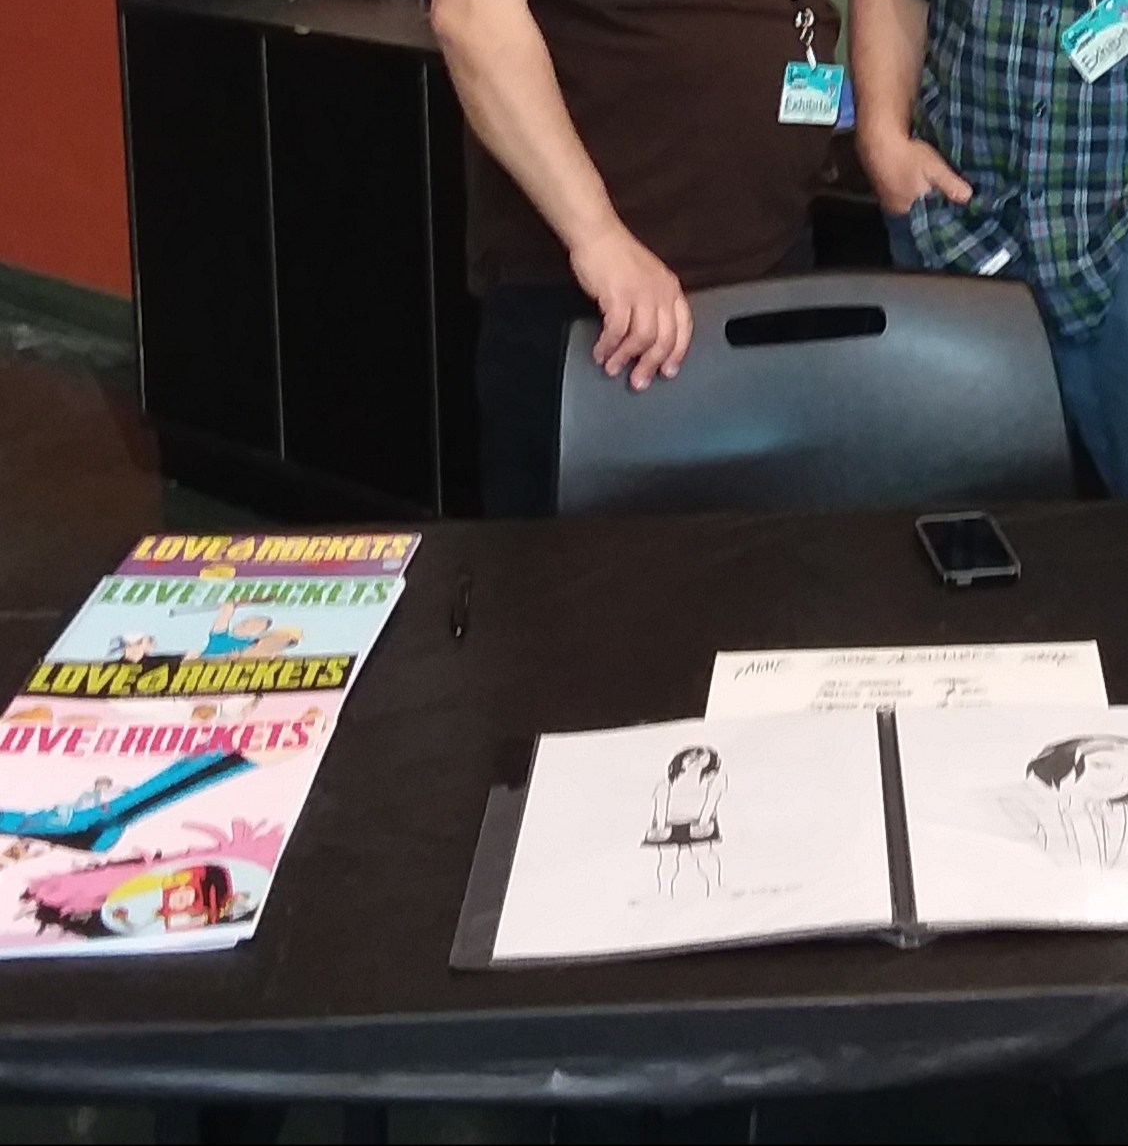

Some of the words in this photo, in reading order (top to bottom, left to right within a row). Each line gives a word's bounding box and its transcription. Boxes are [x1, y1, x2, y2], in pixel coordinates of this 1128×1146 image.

[132, 534, 233, 561] LOVE
[254, 533, 414, 563] ROCKETS
[101, 580, 208, 604] LOVE
[26, 662, 143, 694] LOVE
[168, 656, 351, 694] ROCKETS
[117, 720, 316, 756] ROCKETS
